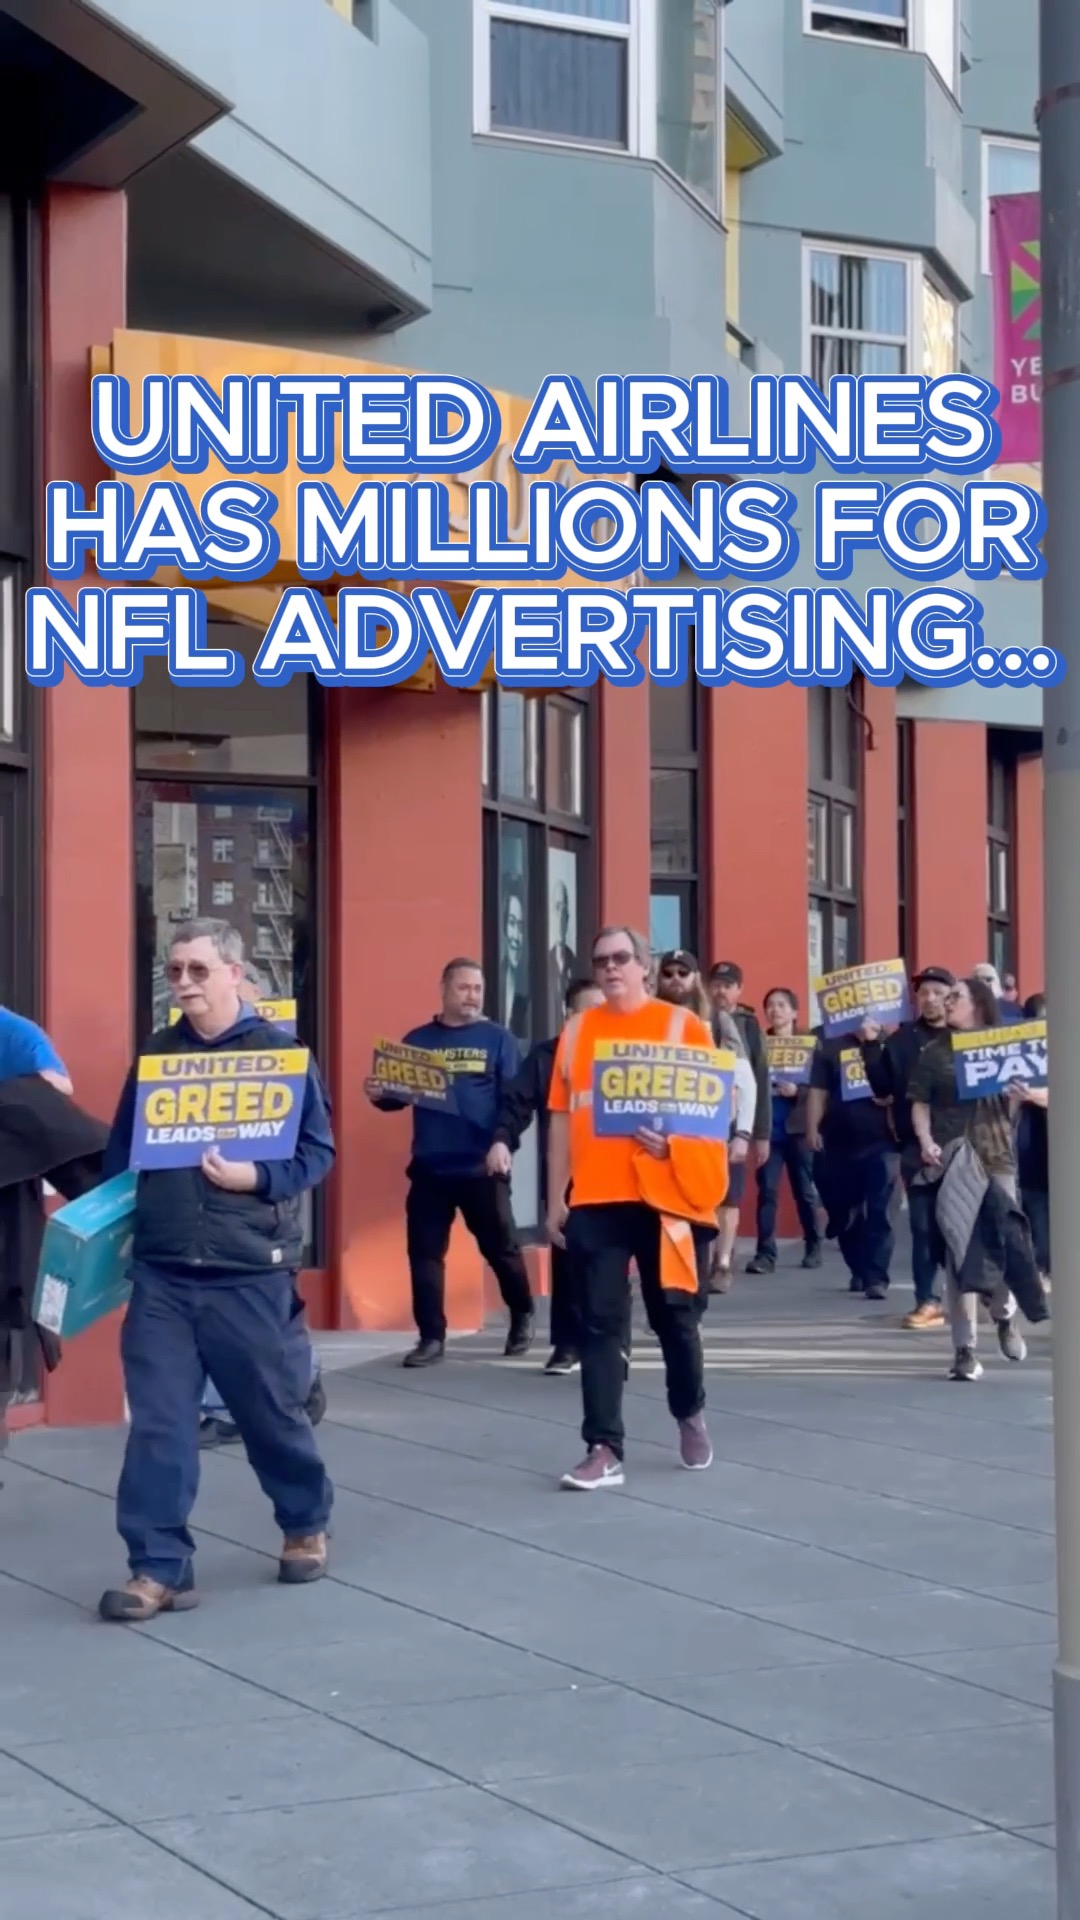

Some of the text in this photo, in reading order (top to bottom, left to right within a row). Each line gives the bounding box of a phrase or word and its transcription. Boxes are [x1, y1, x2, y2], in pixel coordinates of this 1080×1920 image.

[823, 978, 902, 1013] GREED
[162, 1055, 286, 1076] UNITED:
[613, 1043, 718, 1065] UNITED:
[963, 1042, 1021, 1061] TIME
[376, 1056, 446, 1091] GREED
[600, 1065, 725, 1104] GREED
[964, 1053, 1048, 1087] PAY
[144, 1081, 294, 1126] GREED
[603, 1100, 659, 1114] LEADS
[678, 1103, 720, 1119] WAY
[145, 1125, 216, 1144] LEADS
[238, 1120, 286, 1139] WAY
